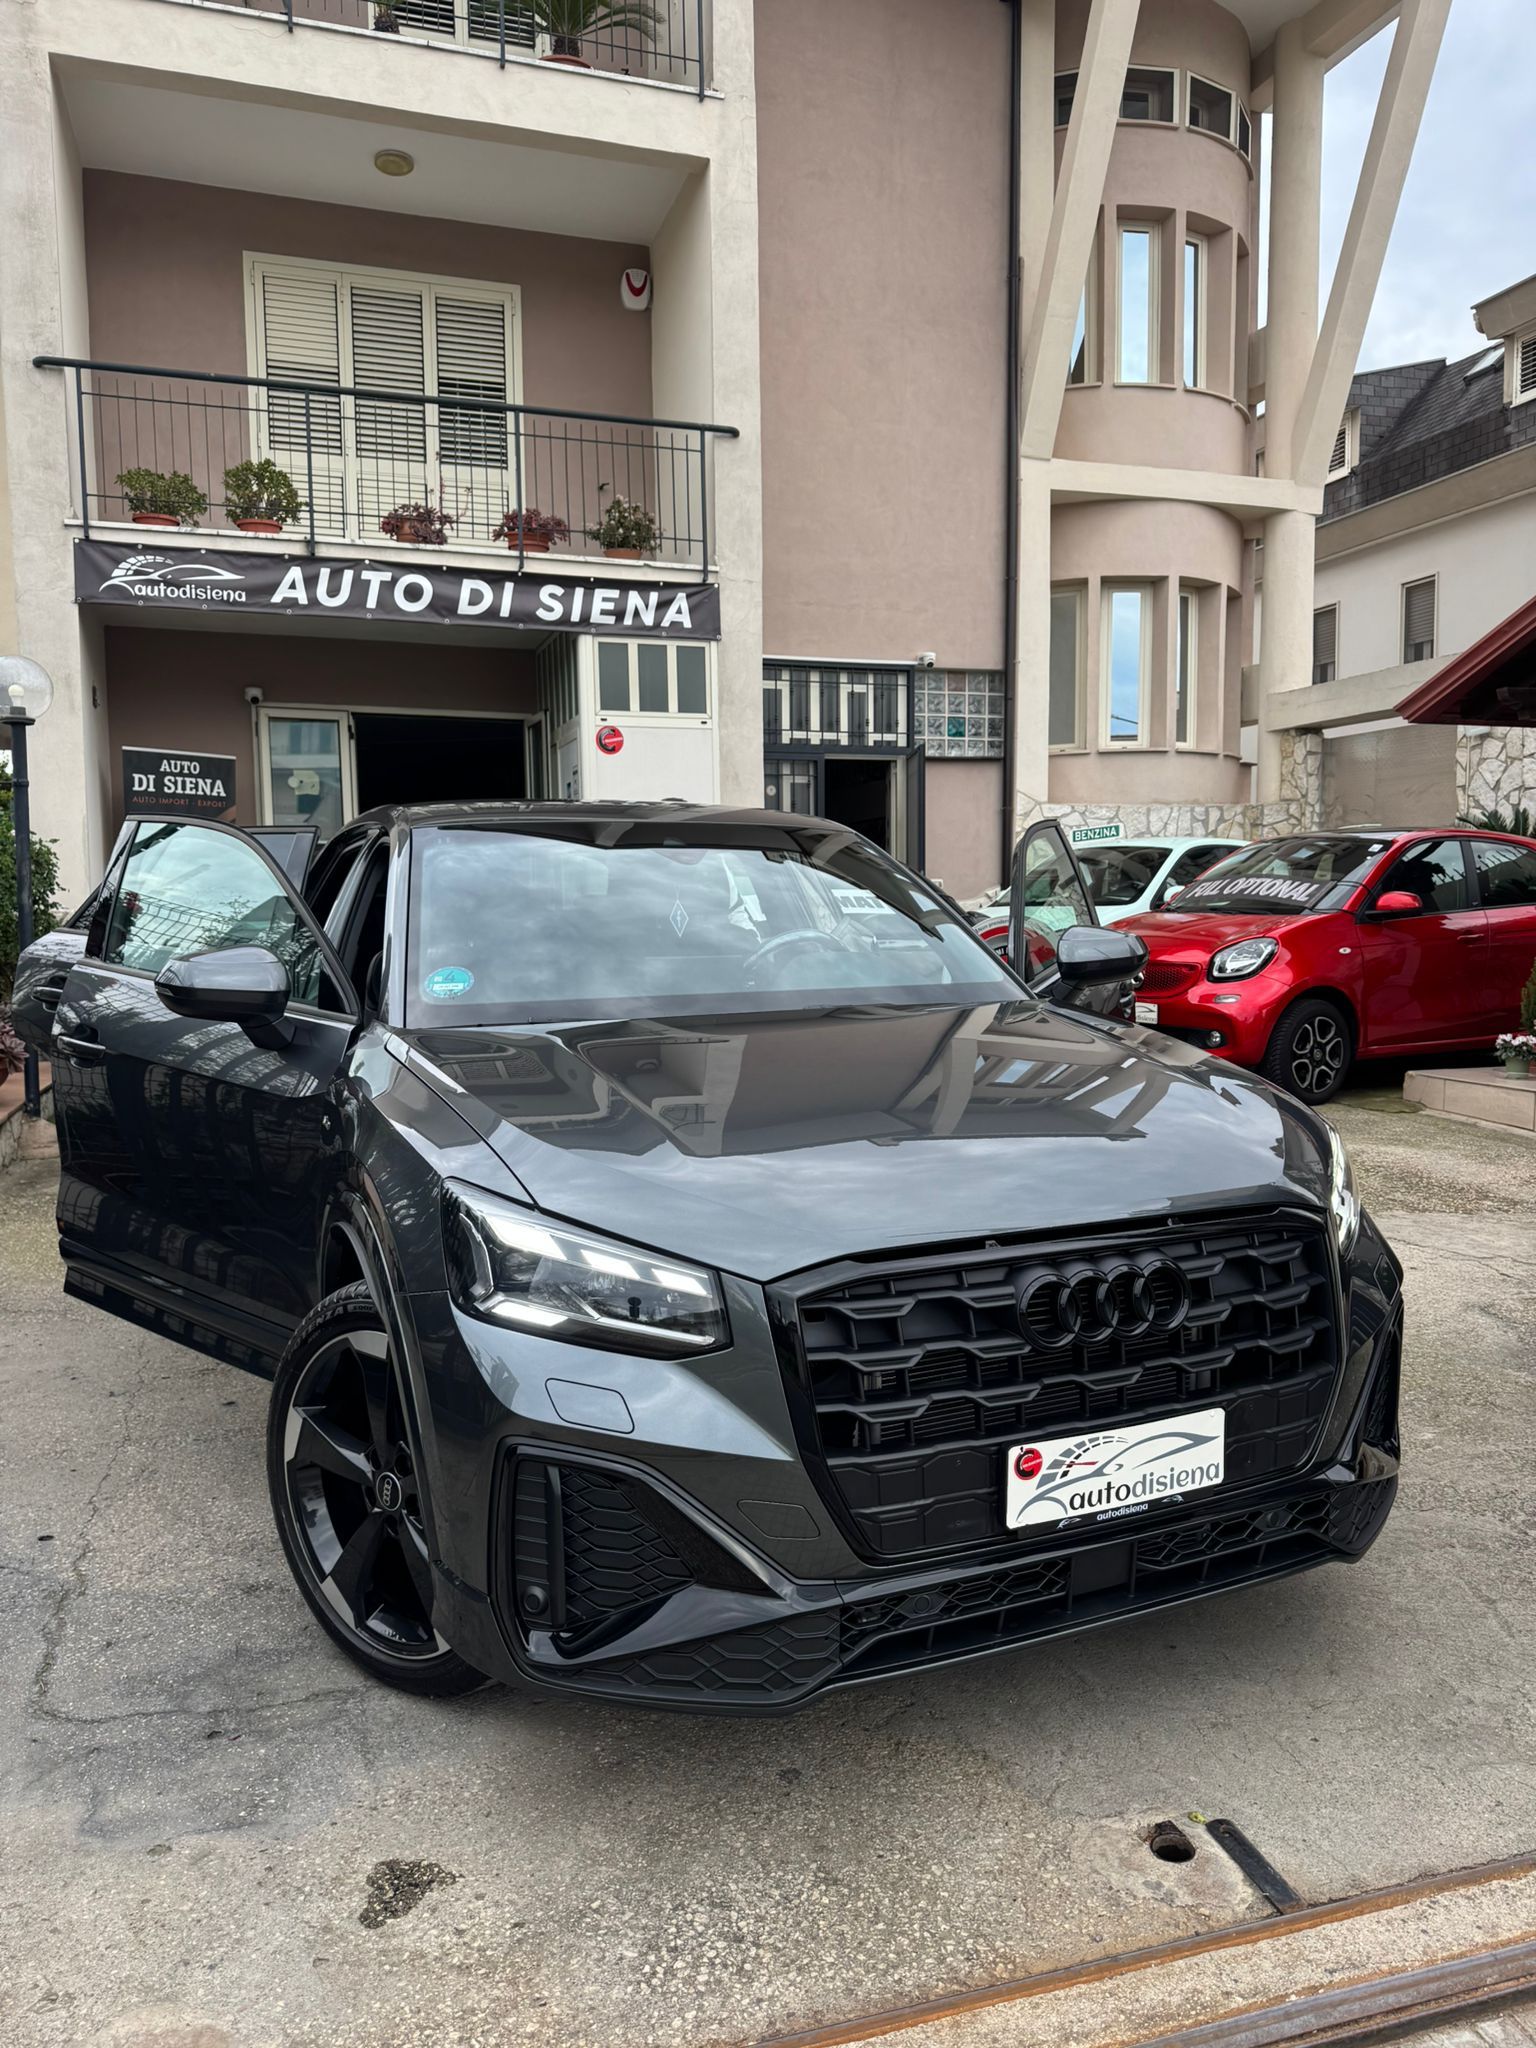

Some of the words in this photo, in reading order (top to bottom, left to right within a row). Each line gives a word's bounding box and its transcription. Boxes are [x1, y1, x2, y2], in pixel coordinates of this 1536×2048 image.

[134, 582, 247, 602] autodisiena
[270, 566, 433, 612] AUTO
[457, 578, 515, 618] DI
[536, 584, 693, 629] SIENA
[160, 759, 200, 775] AUTO
[132, 773, 156, 792] DI
[163, 775, 227, 797] SIENA
[132, 796, 156, 804] AUTO
[159, 798, 189, 806] IMPORT
[197, 800, 227, 808] EXPORT
[1074, 826, 1118, 841] BENZINA
[1185, 878, 1231, 899] FULL
[1222, 877, 1321, 902] OPTIONAL
[1069, 1461, 1221, 1511] autodisiena
[1096, 1502, 1149, 1522] autodisiena
